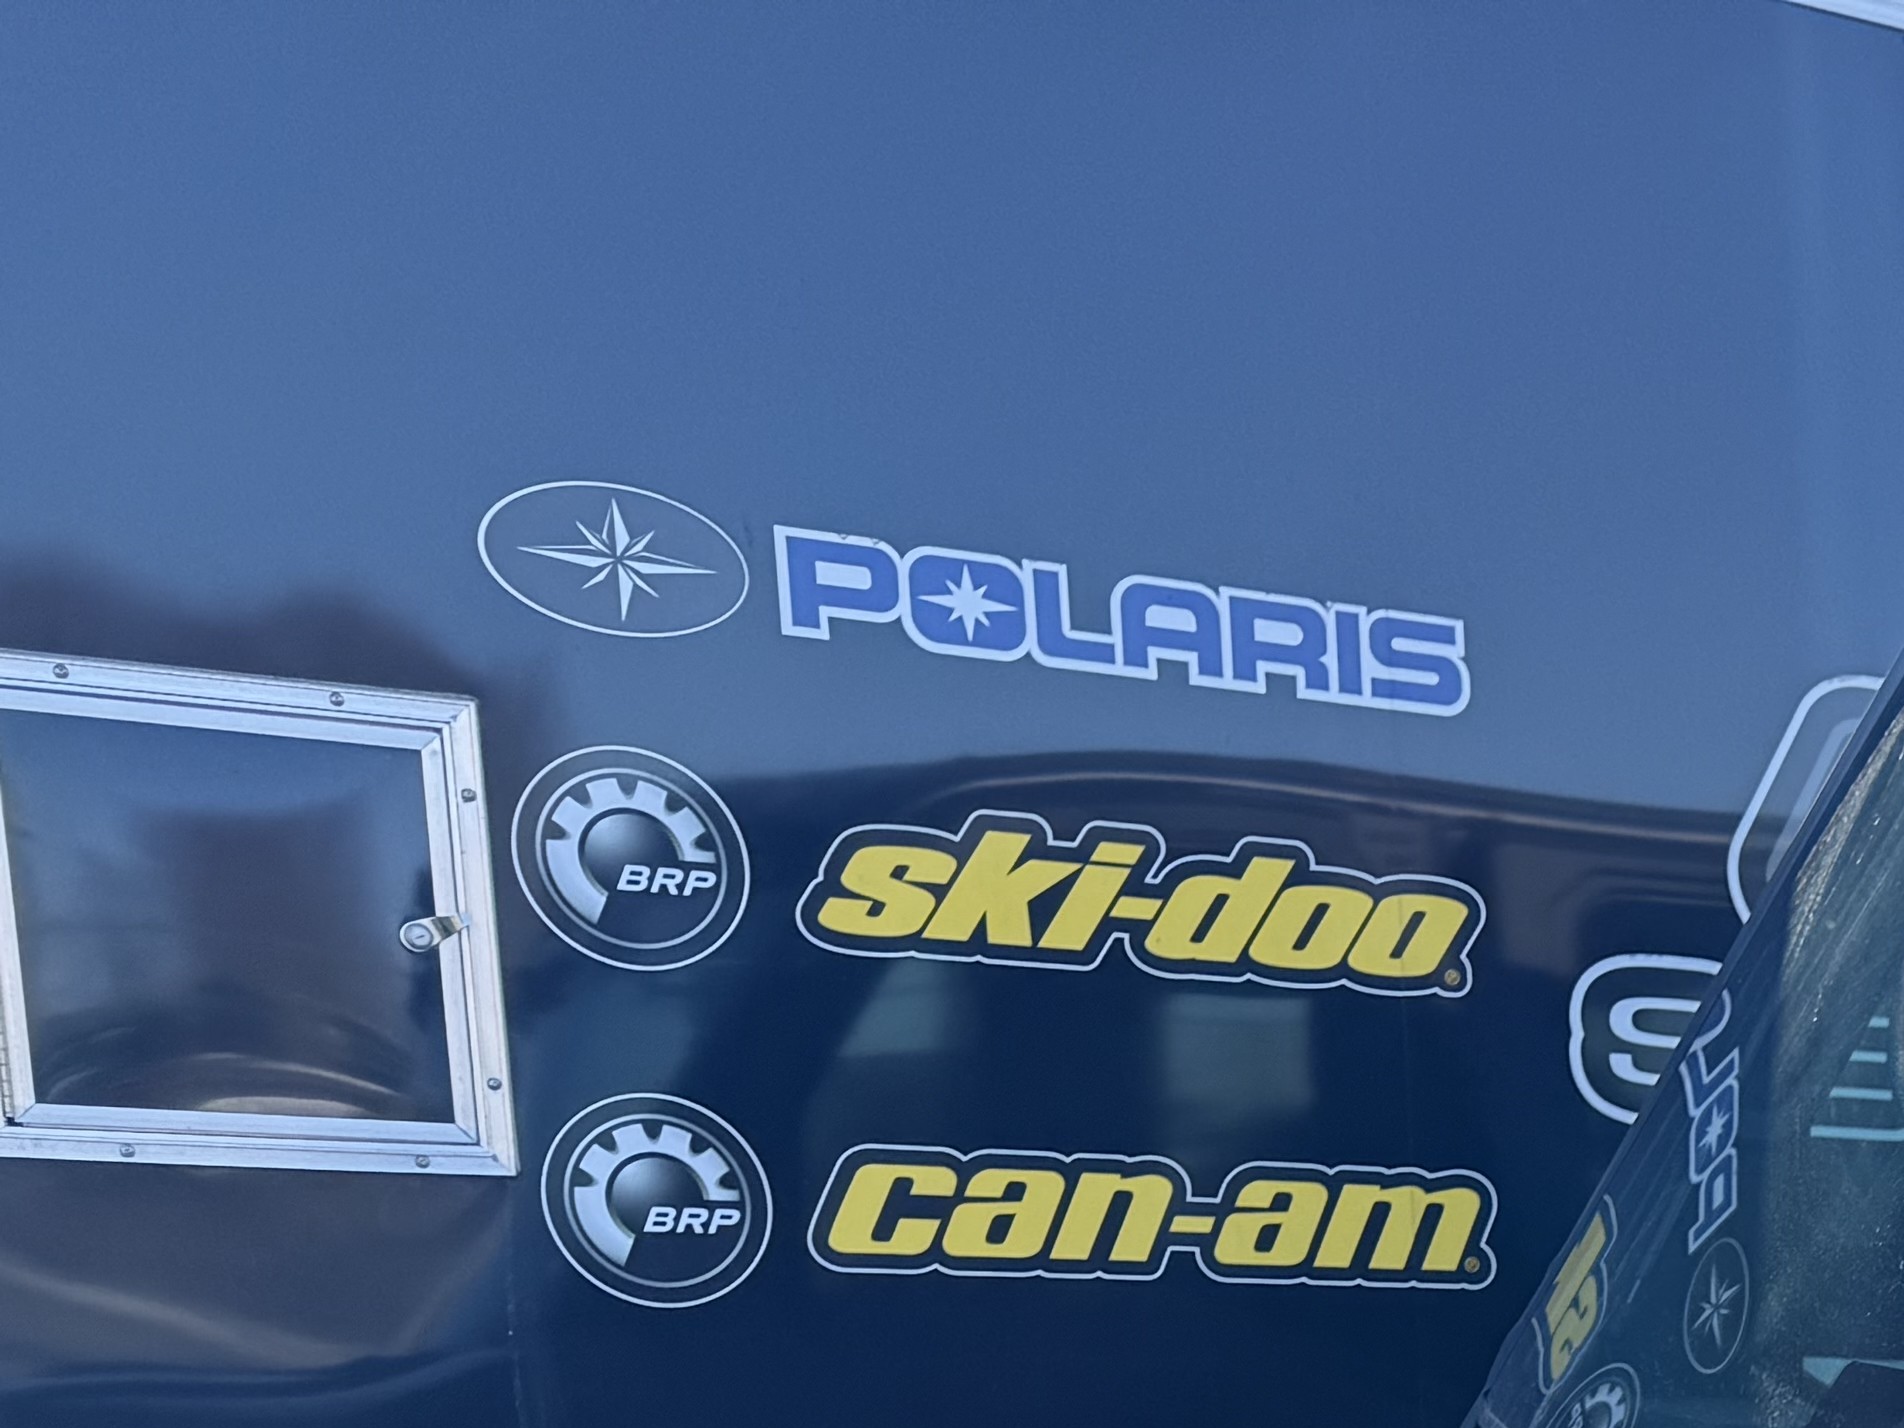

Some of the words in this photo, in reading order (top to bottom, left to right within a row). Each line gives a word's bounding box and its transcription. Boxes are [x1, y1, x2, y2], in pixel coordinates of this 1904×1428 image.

[774, 525, 1472, 717] POLARIS
[616, 864, 718, 897] BRP
[817, 830, 1469, 978] ski-doo
[643, 1206, 742, 1235] BRP
[828, 1163, 1481, 1272] can-am
